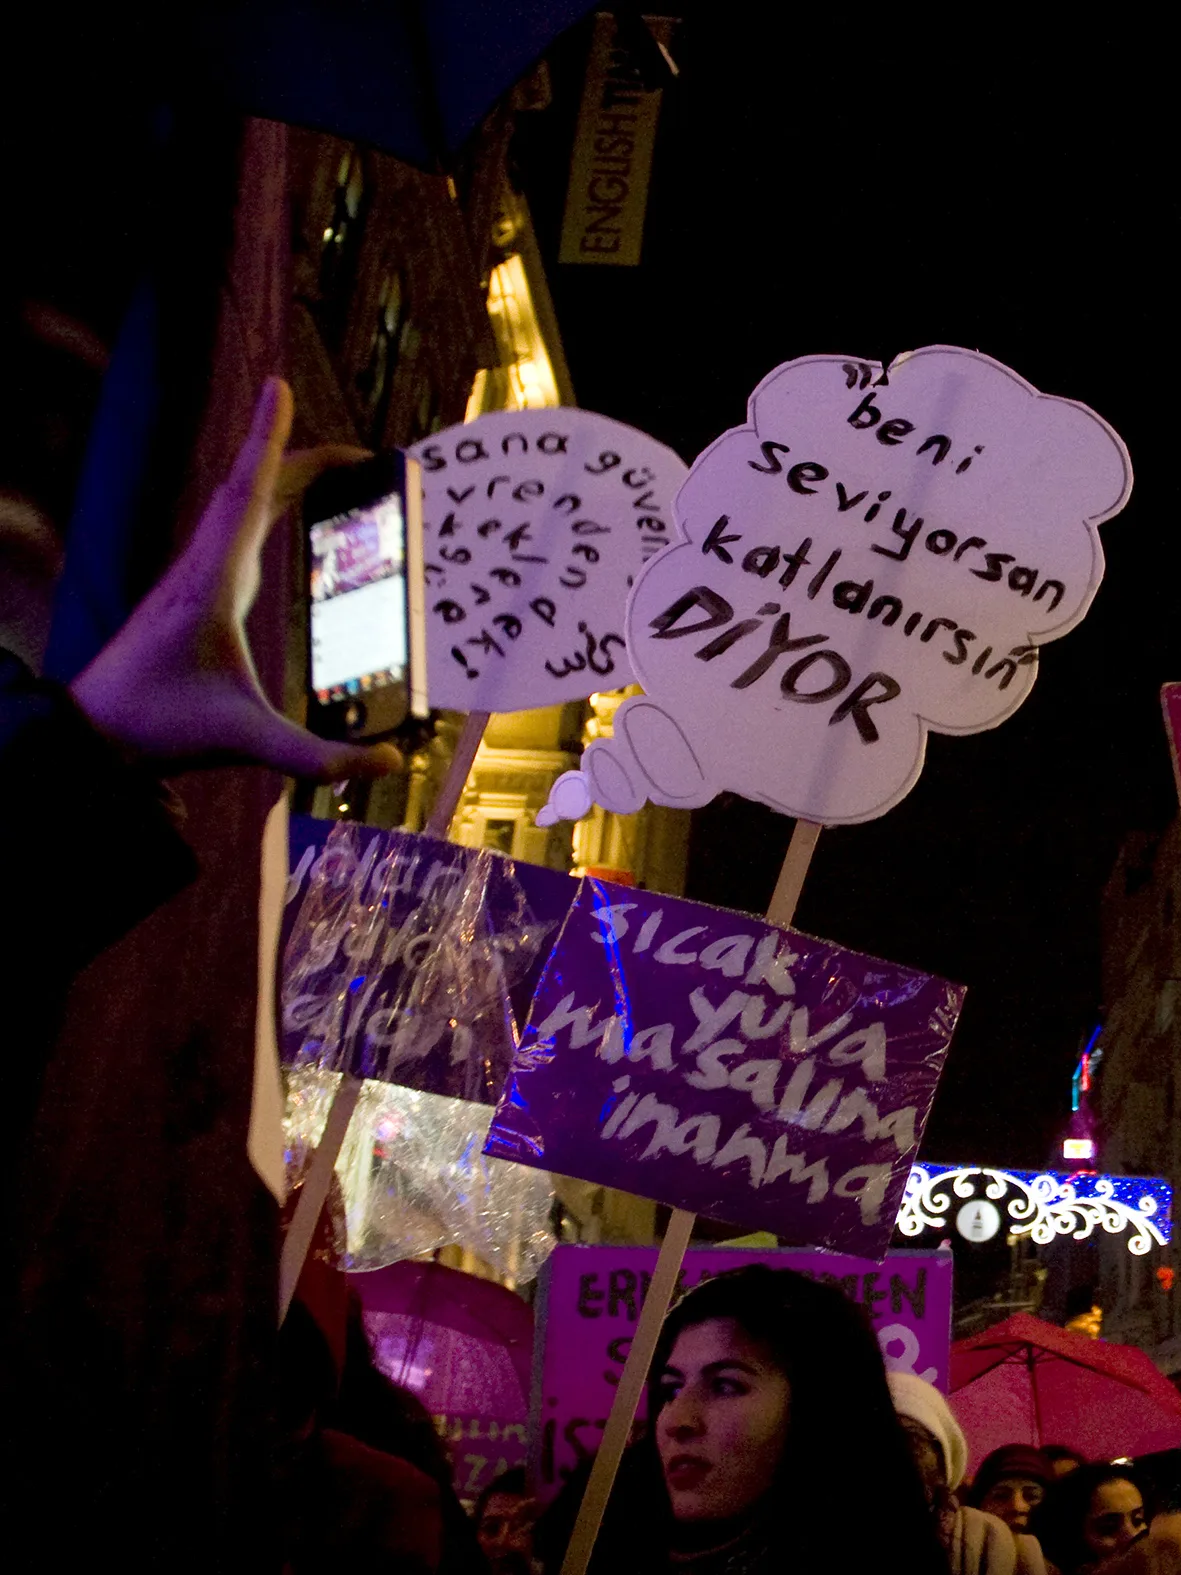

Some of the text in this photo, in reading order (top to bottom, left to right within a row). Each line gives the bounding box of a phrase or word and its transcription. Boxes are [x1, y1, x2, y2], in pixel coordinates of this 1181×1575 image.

[581, 111, 639, 254] ENGLISH
[422, 432, 570, 473] sana
[748, 440, 1066, 613] seviyorsan
[649, 585, 902, 744] DİYOR
[600, 1074, 893, 1226] inanma
